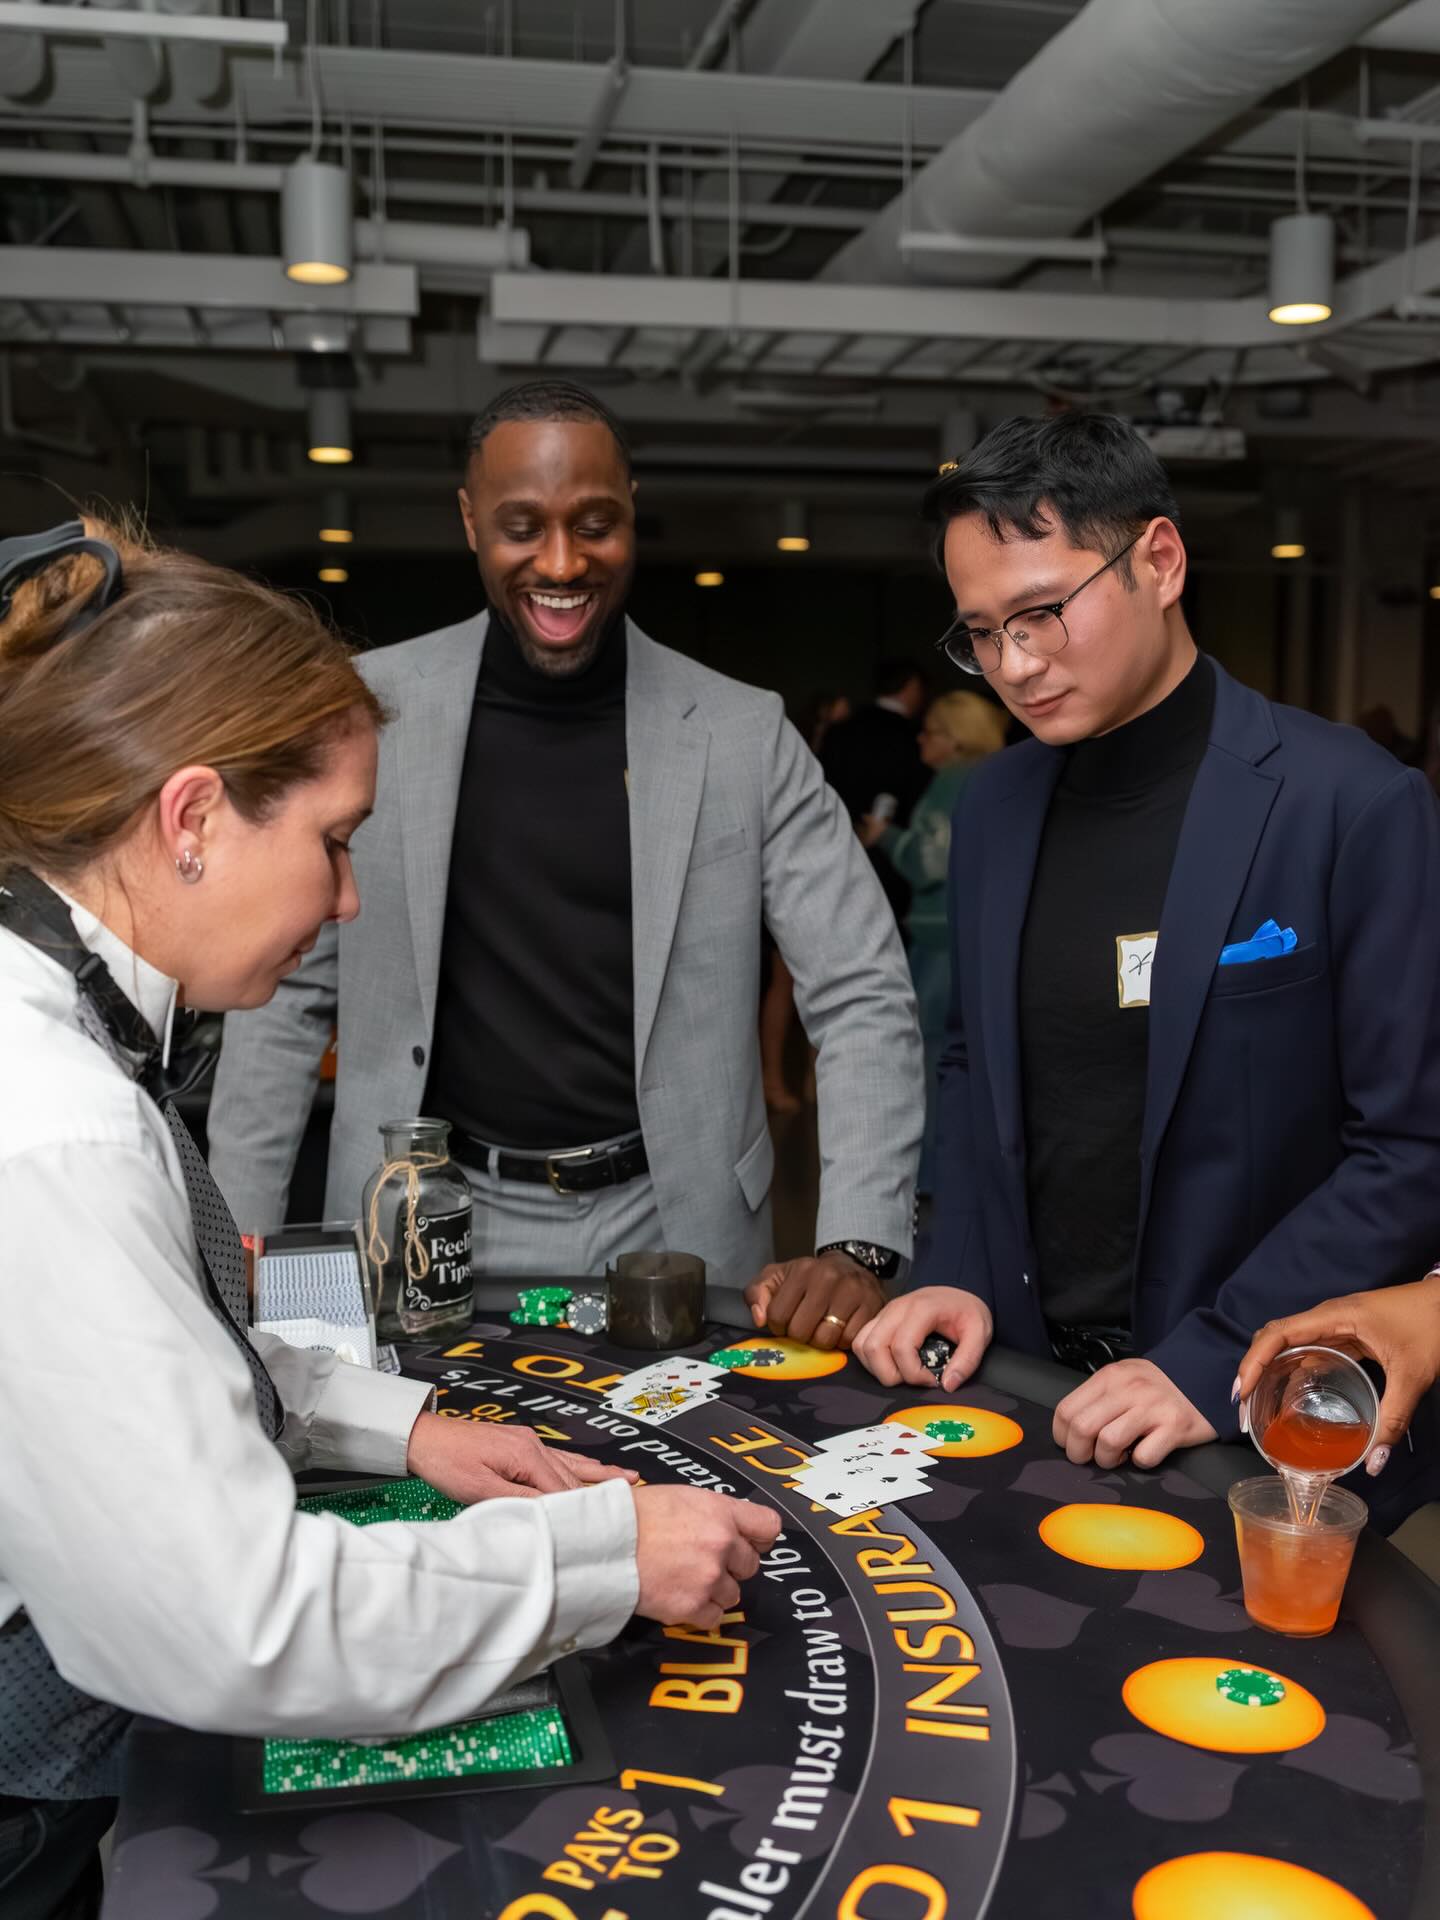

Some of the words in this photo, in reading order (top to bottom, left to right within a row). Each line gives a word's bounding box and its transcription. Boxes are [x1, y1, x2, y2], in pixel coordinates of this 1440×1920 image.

[440, 1369, 524, 1397] 17's
[518, 1395, 589, 1416] all
[585, 1414, 640, 1437] on
[790, 1588, 833, 1622] to
[784, 1626, 847, 1716] draw
[619, 1768, 725, 1797] 1
[770, 1721, 846, 1831] must
[888, 1796, 981, 1837] 1
[542, 1806, 644, 1891] PAYS
[607, 1832, 681, 1880] TO
